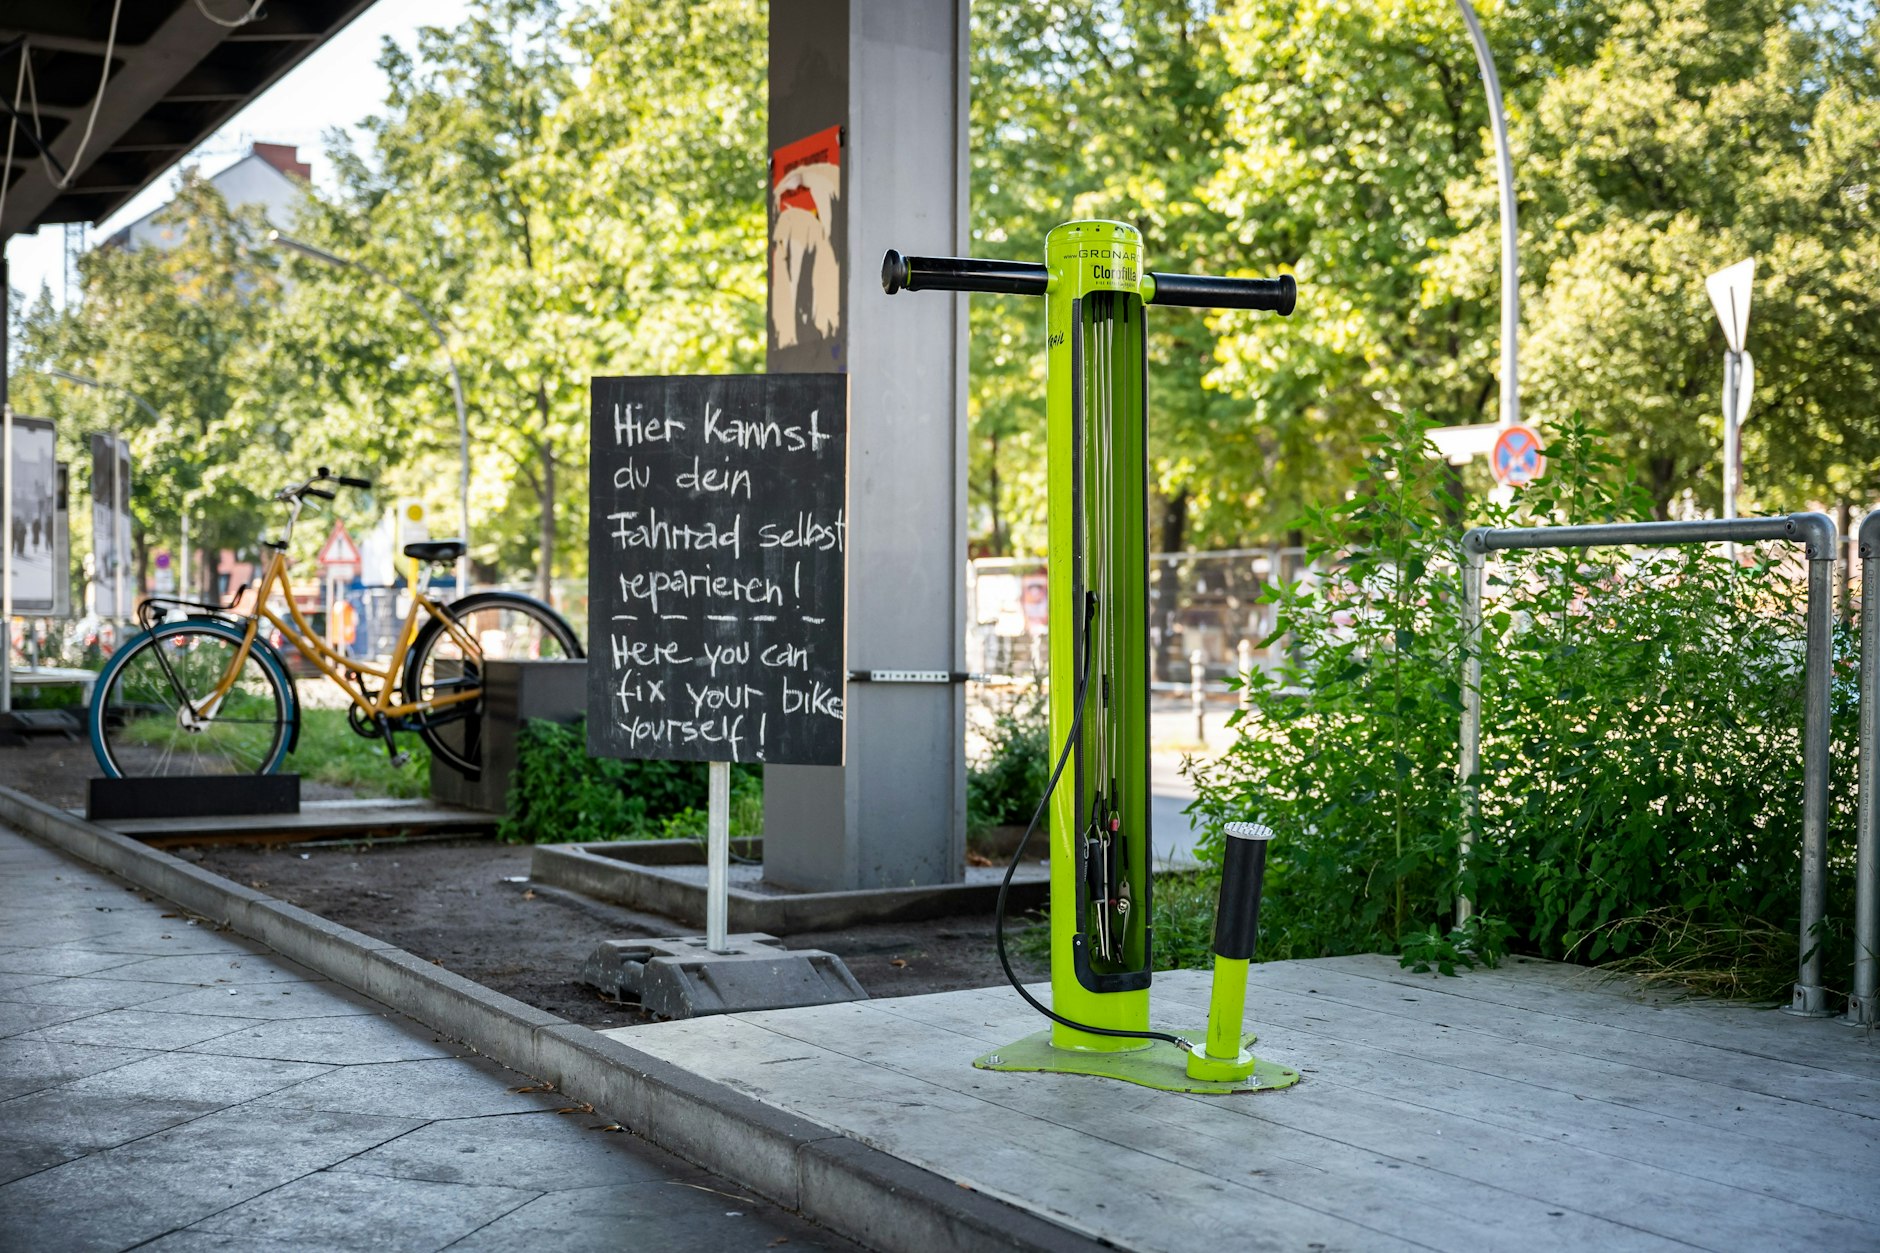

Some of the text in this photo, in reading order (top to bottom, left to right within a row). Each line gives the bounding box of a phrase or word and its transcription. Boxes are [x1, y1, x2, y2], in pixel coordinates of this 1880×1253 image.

[1093, 265, 1137, 282] Clorofilla
[614, 402, 686, 447] Hier
[613, 455, 752, 499] du dein
[607, 507, 847, 560] Fahrrad selbst
[611, 634, 808, 678] Here you can
[616, 669, 845, 720] fix your bike
